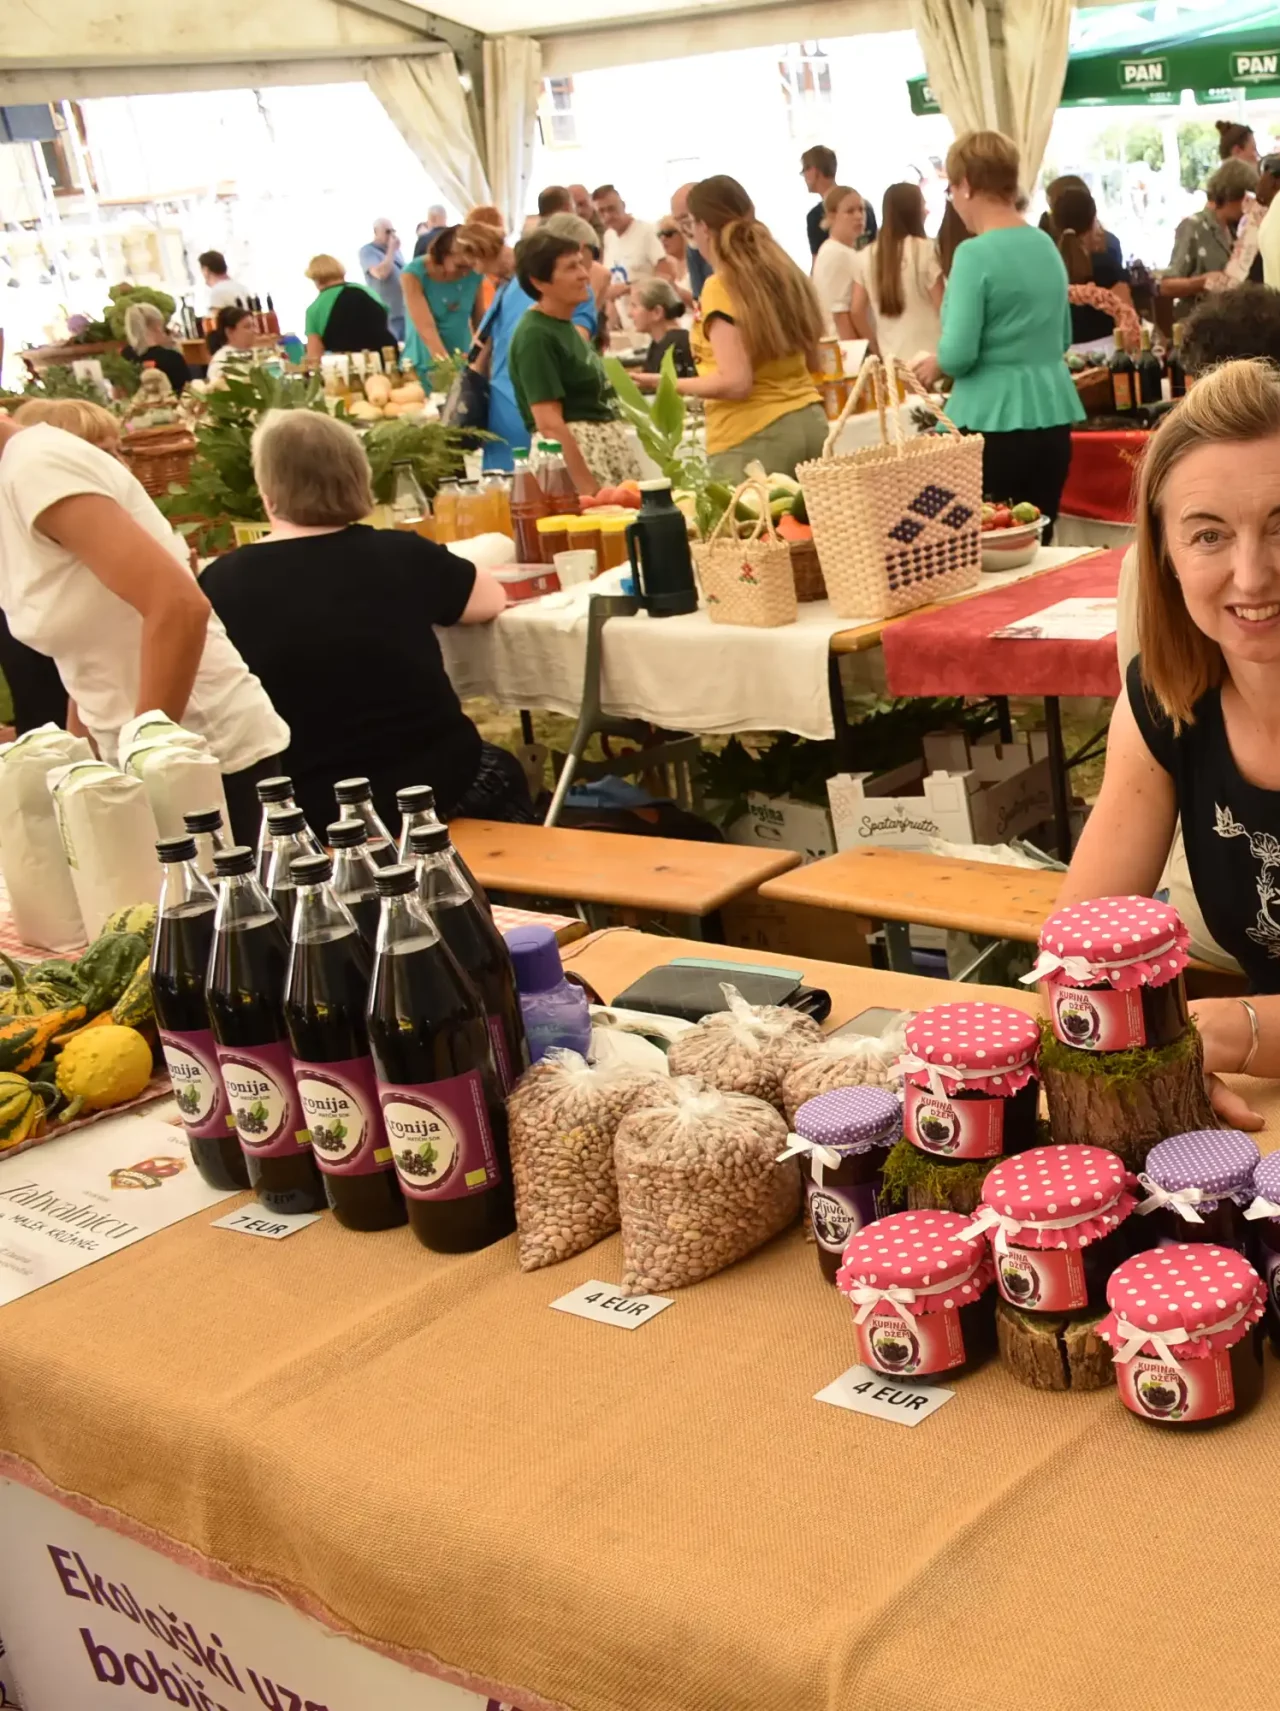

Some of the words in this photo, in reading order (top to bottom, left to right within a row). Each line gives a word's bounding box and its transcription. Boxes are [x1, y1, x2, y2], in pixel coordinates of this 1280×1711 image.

[1124, 63, 1163, 82] PAN
[1236, 55, 1278, 74] PAN
[751, 805, 784, 822] egina
[1060, 990, 1089, 1003] KUPINA
[169, 1063, 202, 1079] onija
[226, 1079, 270, 1097] ronija
[303, 1097, 349, 1115] ronija
[920, 1096, 953, 1111] KUPINA
[385, 1116, 441, 1138] ronija
[0, 1180, 139, 1239] Zahvalnicu
[9, 1214, 48, 1231] MALEK
[230, 1216, 251, 1226] 7
[244, 1220, 289, 1234] EUR
[1008, 1252, 1029, 1262] PINA
[584, 1292, 604, 1304] 4
[600, 1296, 650, 1316] EUR
[872, 1319, 907, 1330] KUPINA
[1138, 1362, 1176, 1374] KUPINA
[852, 1381, 875, 1394] 4
[871, 1386, 929, 1411] EUR
[46, 1544, 246, 1694] Ekološki
